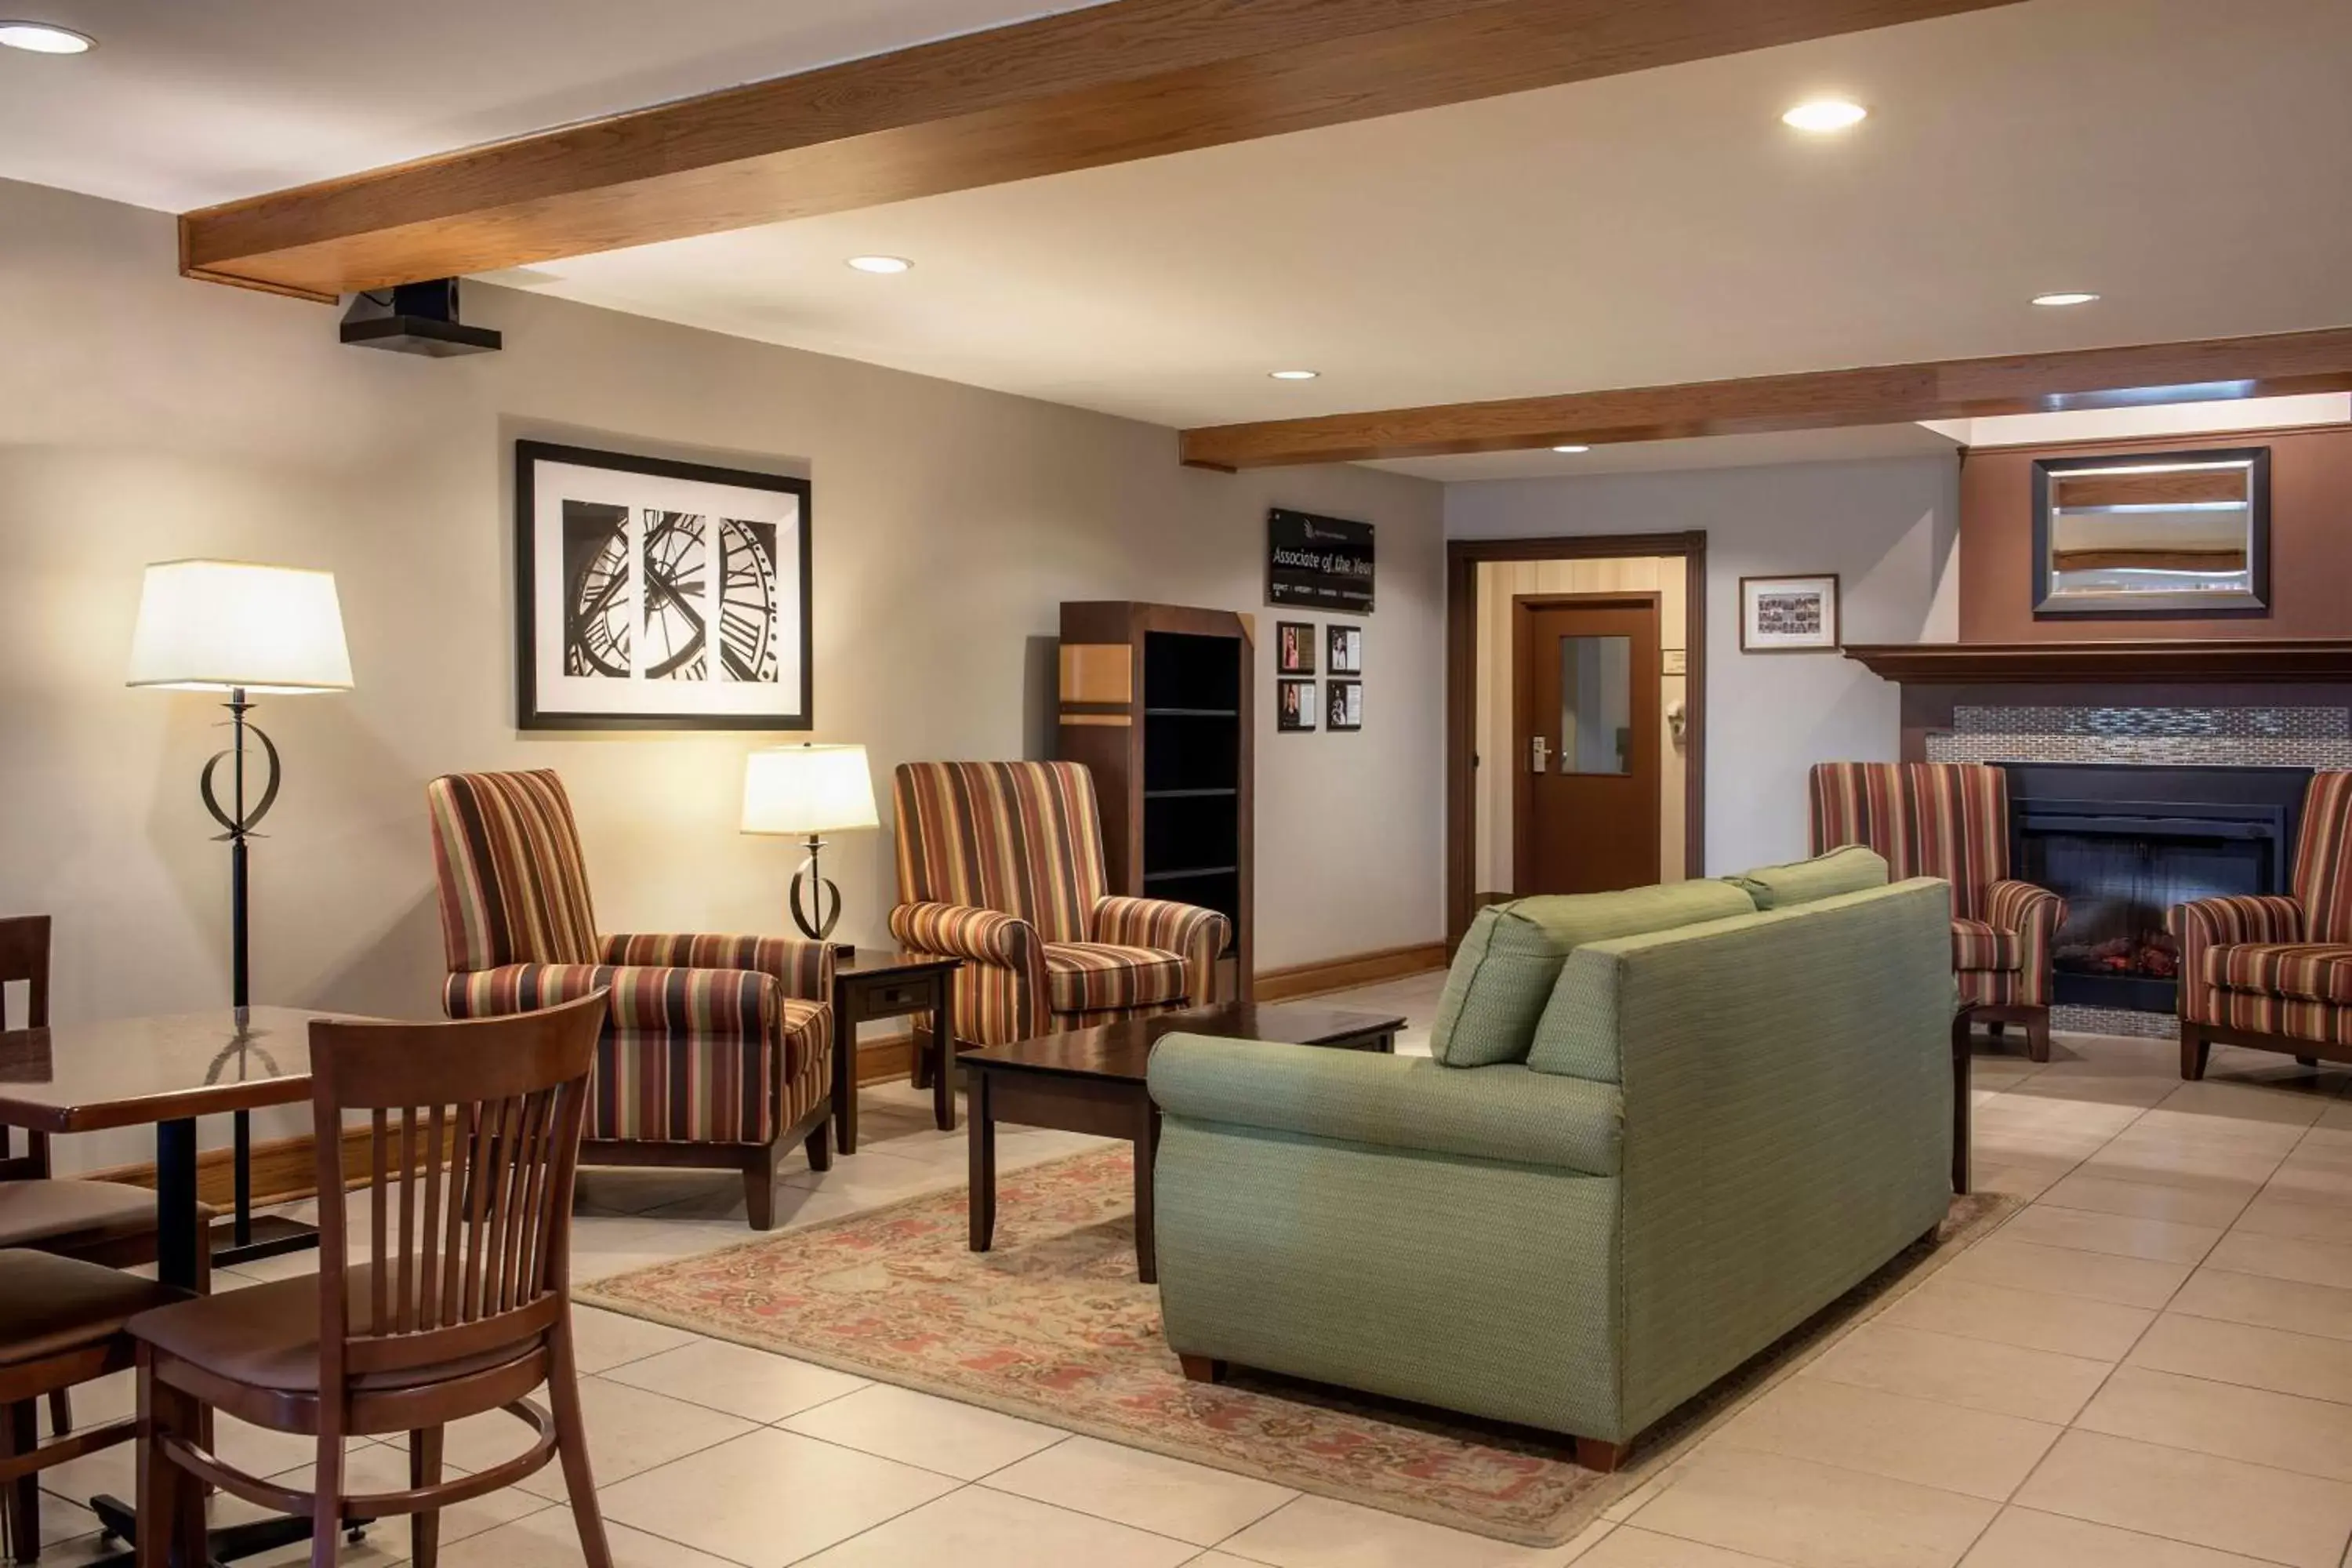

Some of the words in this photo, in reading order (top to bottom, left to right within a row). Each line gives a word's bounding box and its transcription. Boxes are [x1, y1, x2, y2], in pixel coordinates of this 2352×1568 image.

[1273, 546, 1320, 568] Associate
[1322, 553, 1333, 573] of
[1335, 554, 1351, 572] the
[1353, 557, 1372, 575] Year
